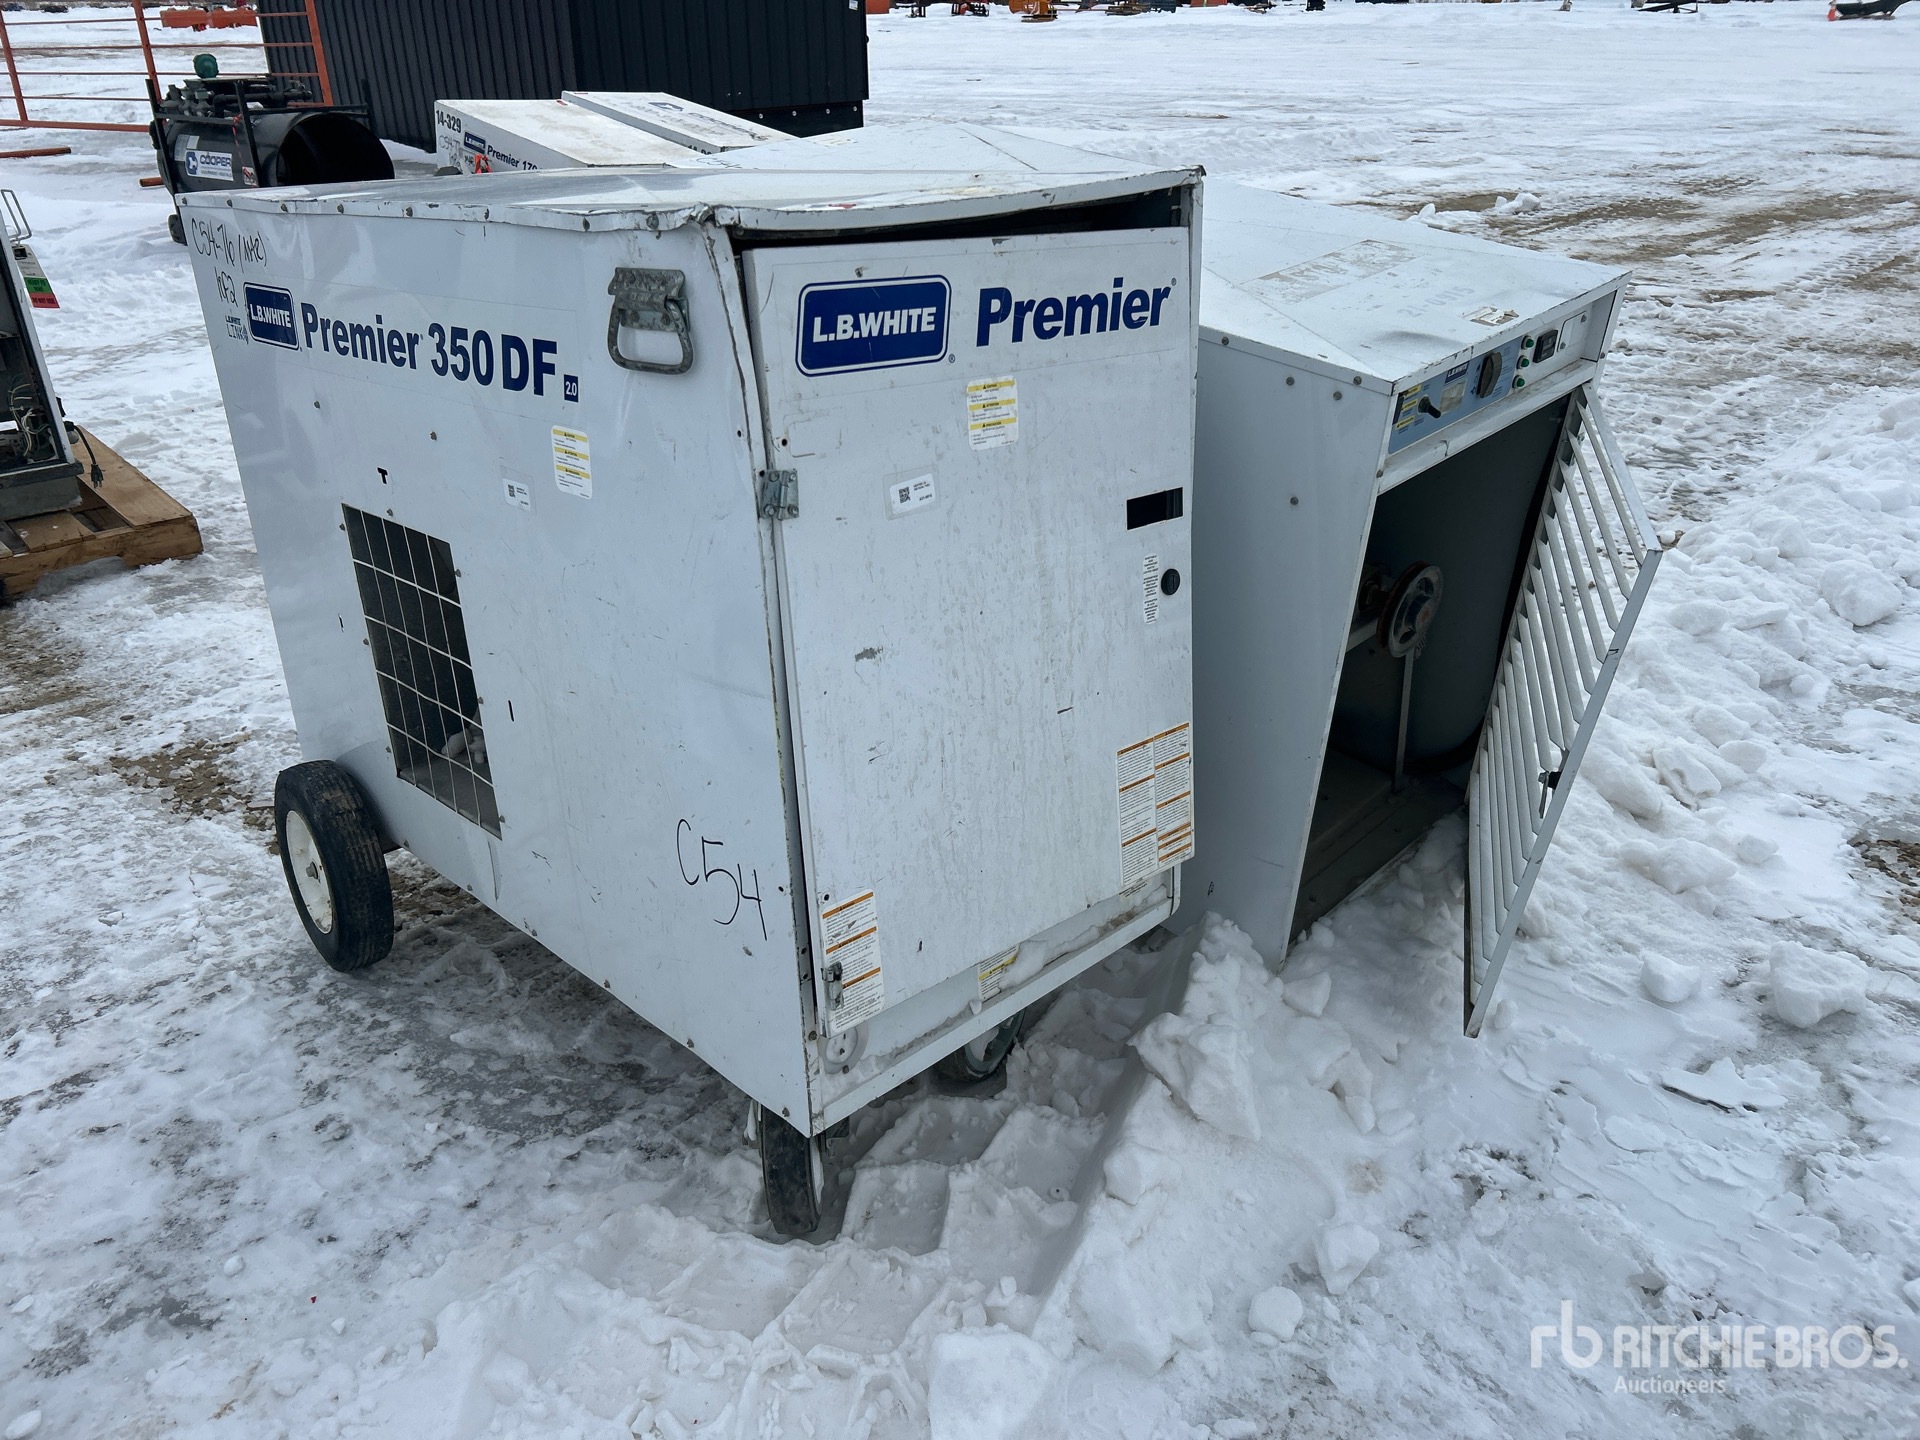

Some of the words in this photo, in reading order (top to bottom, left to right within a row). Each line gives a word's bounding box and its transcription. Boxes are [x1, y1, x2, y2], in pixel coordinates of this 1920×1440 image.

[435, 109, 462, 134] 14-329
[199, 154, 231, 167] COOPER
[487, 145, 521, 168] Premier
[249, 303, 292, 328] L.B.WHITE
[812, 306, 937, 343] L.B.WHITE
[976, 277, 1172, 347] Premier
[300, 302, 420, 370] Premier
[428, 322, 494, 387] 350
[501, 334, 558, 397] DF
[677, 818, 768, 941] C54
